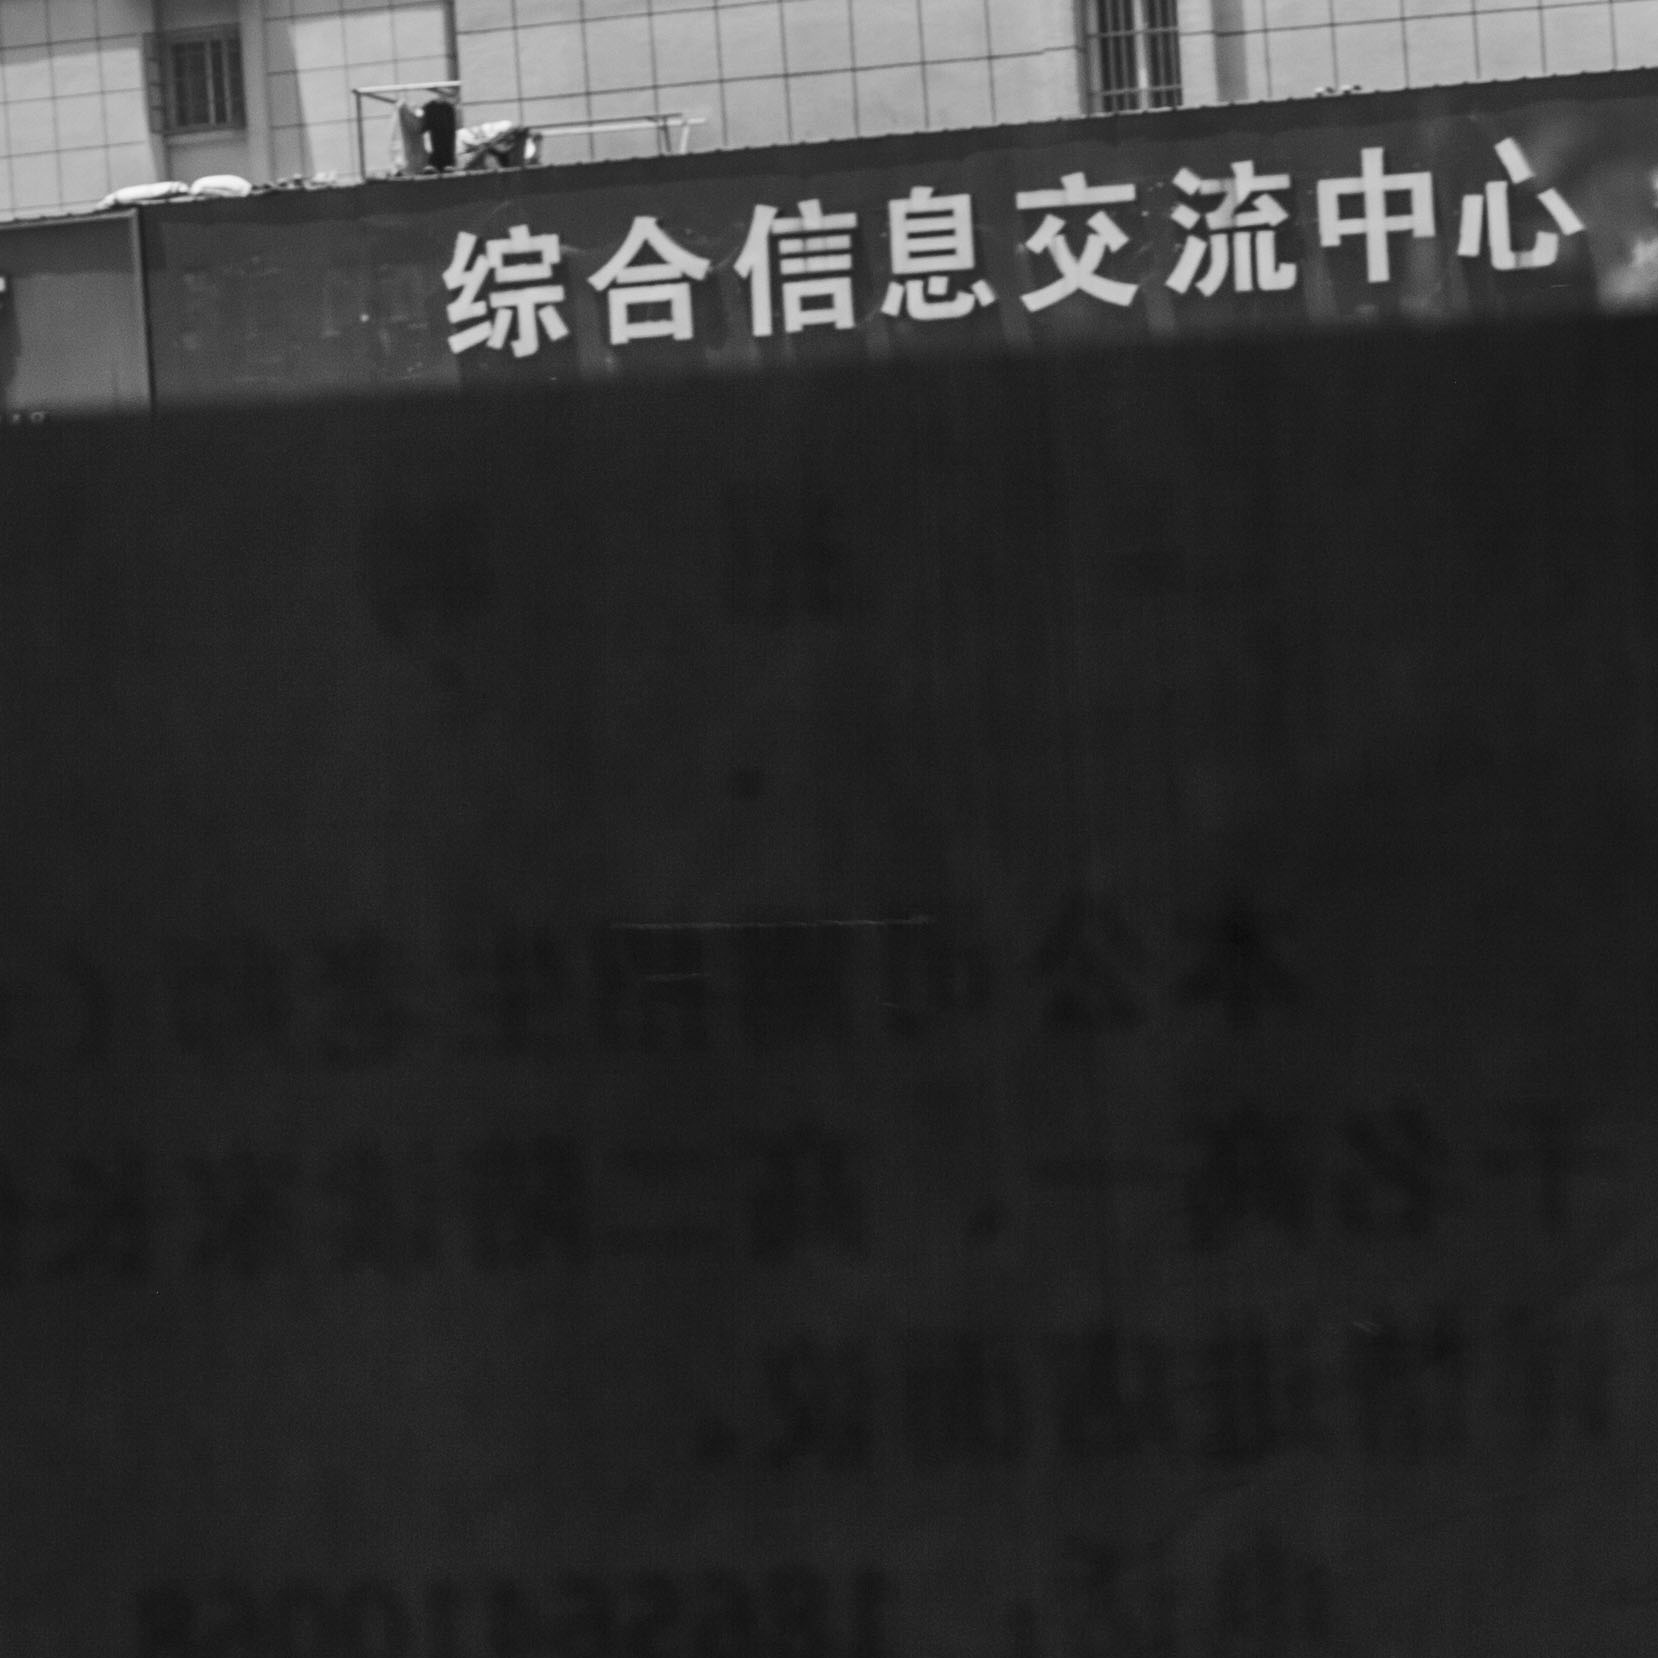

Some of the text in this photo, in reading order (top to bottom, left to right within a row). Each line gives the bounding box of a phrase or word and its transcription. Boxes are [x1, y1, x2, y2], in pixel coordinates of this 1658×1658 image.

[441, 137, 1586, 360] 综合信息交流中心
